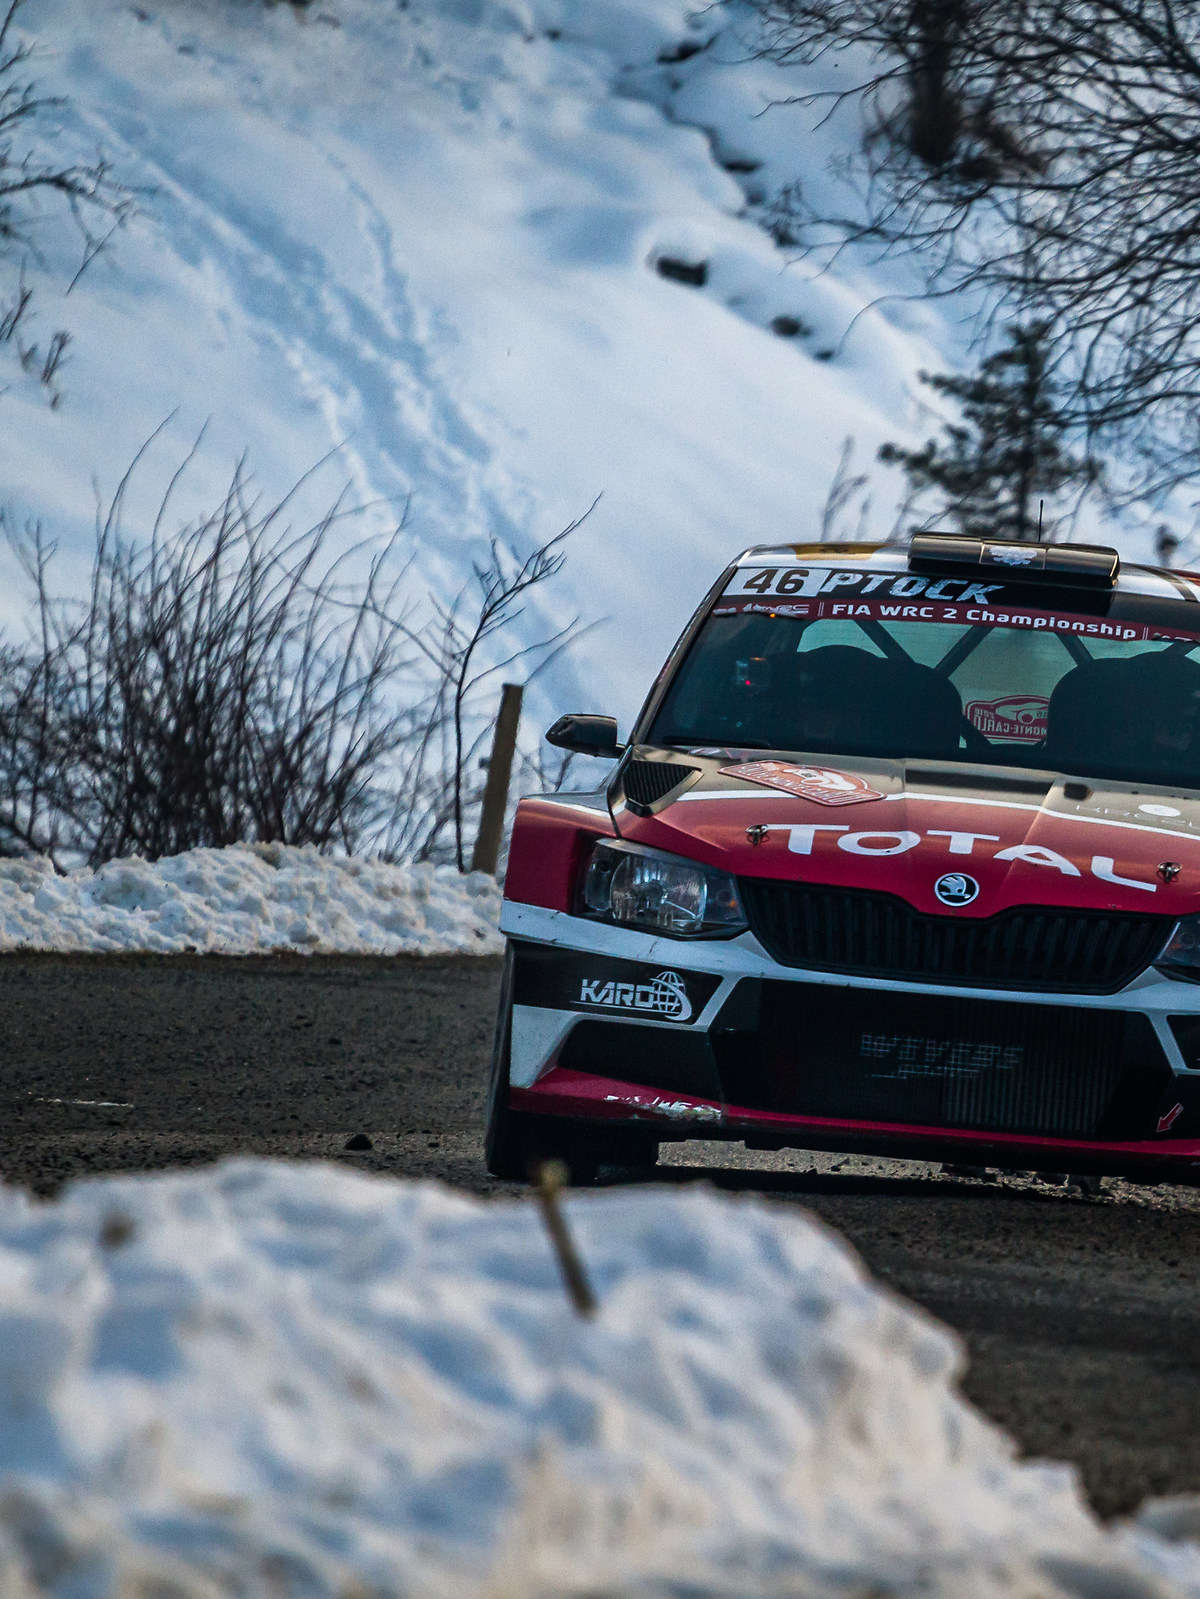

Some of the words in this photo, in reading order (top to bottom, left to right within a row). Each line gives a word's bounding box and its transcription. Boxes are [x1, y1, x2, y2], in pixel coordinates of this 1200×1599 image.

[743, 569, 810, 594] 46
[818, 572, 1004, 605] PTOCK
[832, 604, 872, 616] FIA
[880, 605, 934, 618] WRC
[943, 608, 957, 620] 2
[966, 609, 1137, 639] Championship
[766, 823, 1157, 892] TOTAL
[580, 978, 655, 1008] KARO
